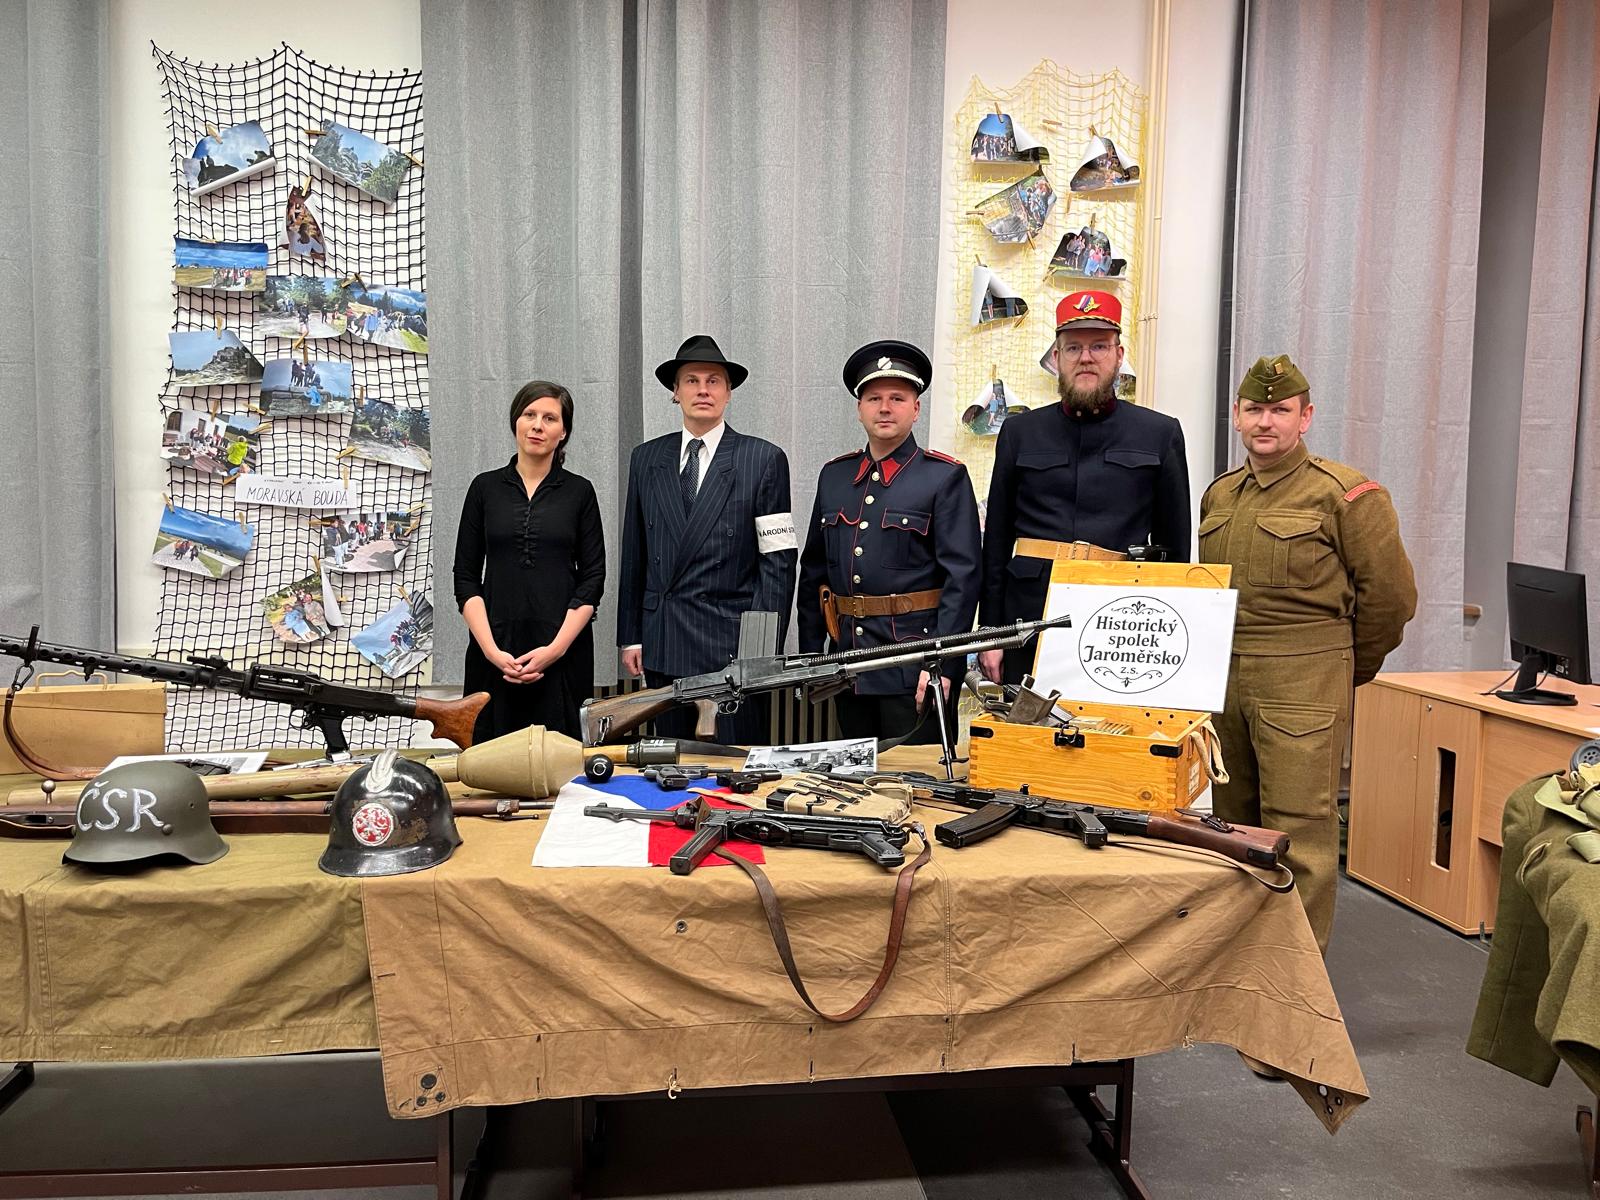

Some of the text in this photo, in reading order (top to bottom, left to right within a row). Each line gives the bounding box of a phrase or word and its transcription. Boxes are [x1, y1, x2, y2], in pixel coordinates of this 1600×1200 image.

[246, 487, 349, 506] MORAVSKÁ BOUDA
[1095, 615, 1178, 636] Historický
[1108, 633, 1160, 648] spolek
[1083, 645, 1181, 665] Jaroměřsko
[1120, 666, 1139, 675] z.s.
[77, 780, 164, 832] ČSR
